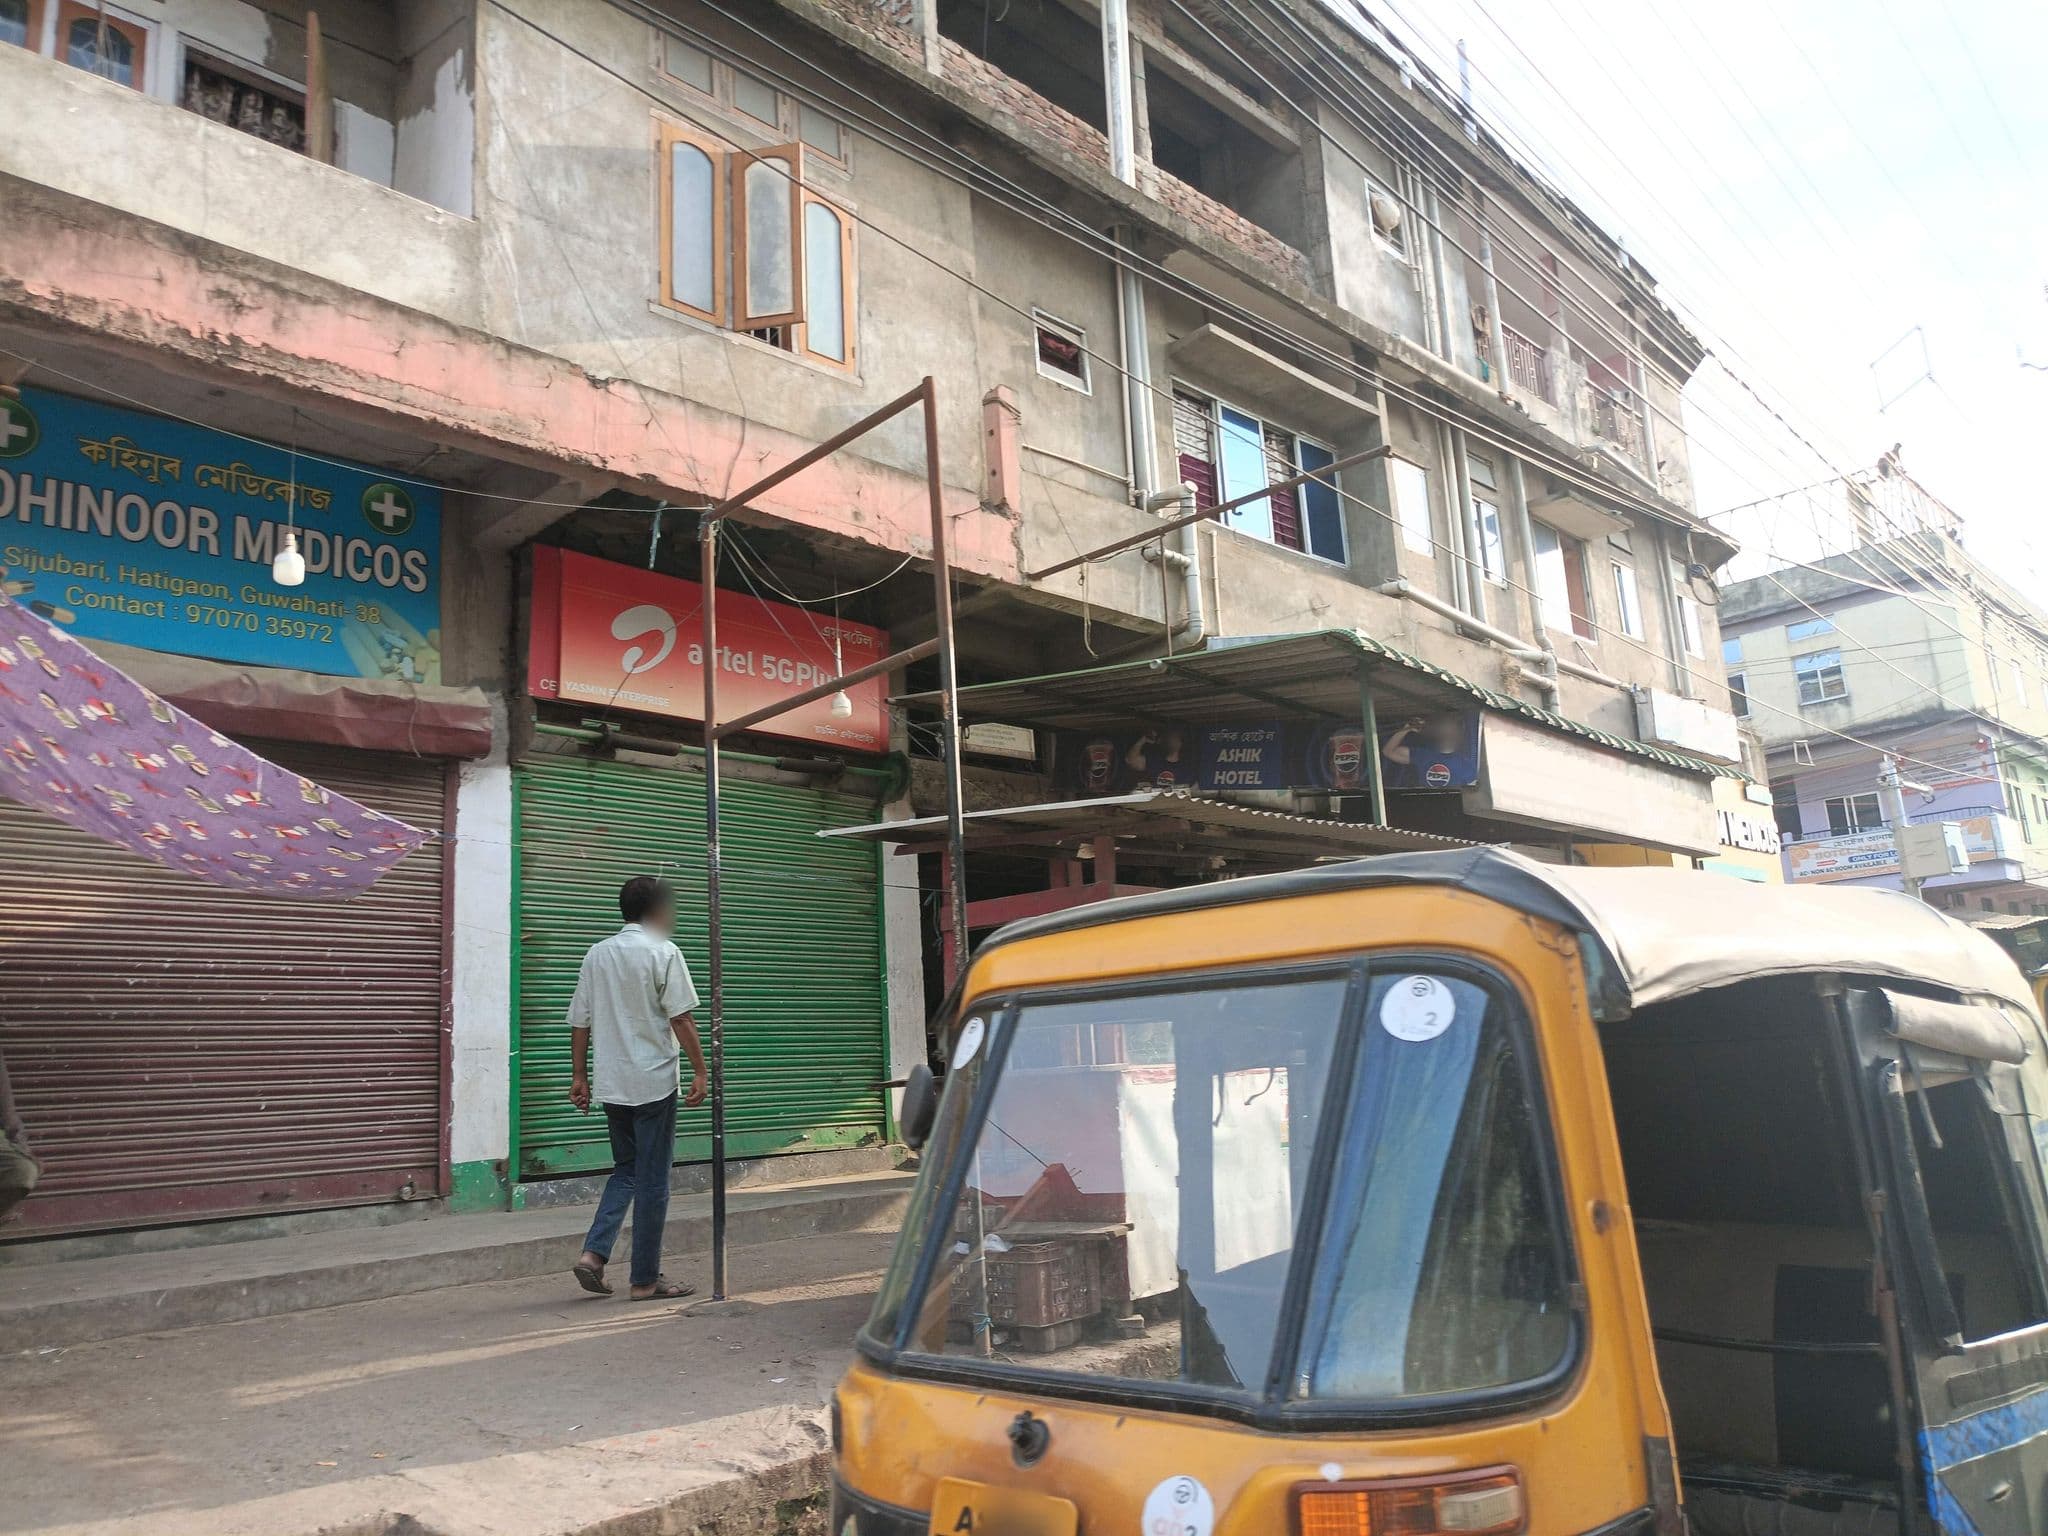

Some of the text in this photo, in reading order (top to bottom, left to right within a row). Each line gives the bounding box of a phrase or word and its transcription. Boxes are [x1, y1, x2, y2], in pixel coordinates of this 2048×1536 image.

[3, 546, 111, 583] Sijubari,
[119, 564, 234, 602] Hatigaon,
[356, 604, 381, 624] 38
[65, 586, 166, 618] Contact
[186, 604, 259, 632] 97070
[266, 616, 333, 643] 35972
[688, 643, 756, 677] artel
[565, 681, 671, 707] YASMIN ENTERPRISE
[1216, 748, 1262, 762] ASHIK
[1213, 770, 1262, 784] HOTEL
